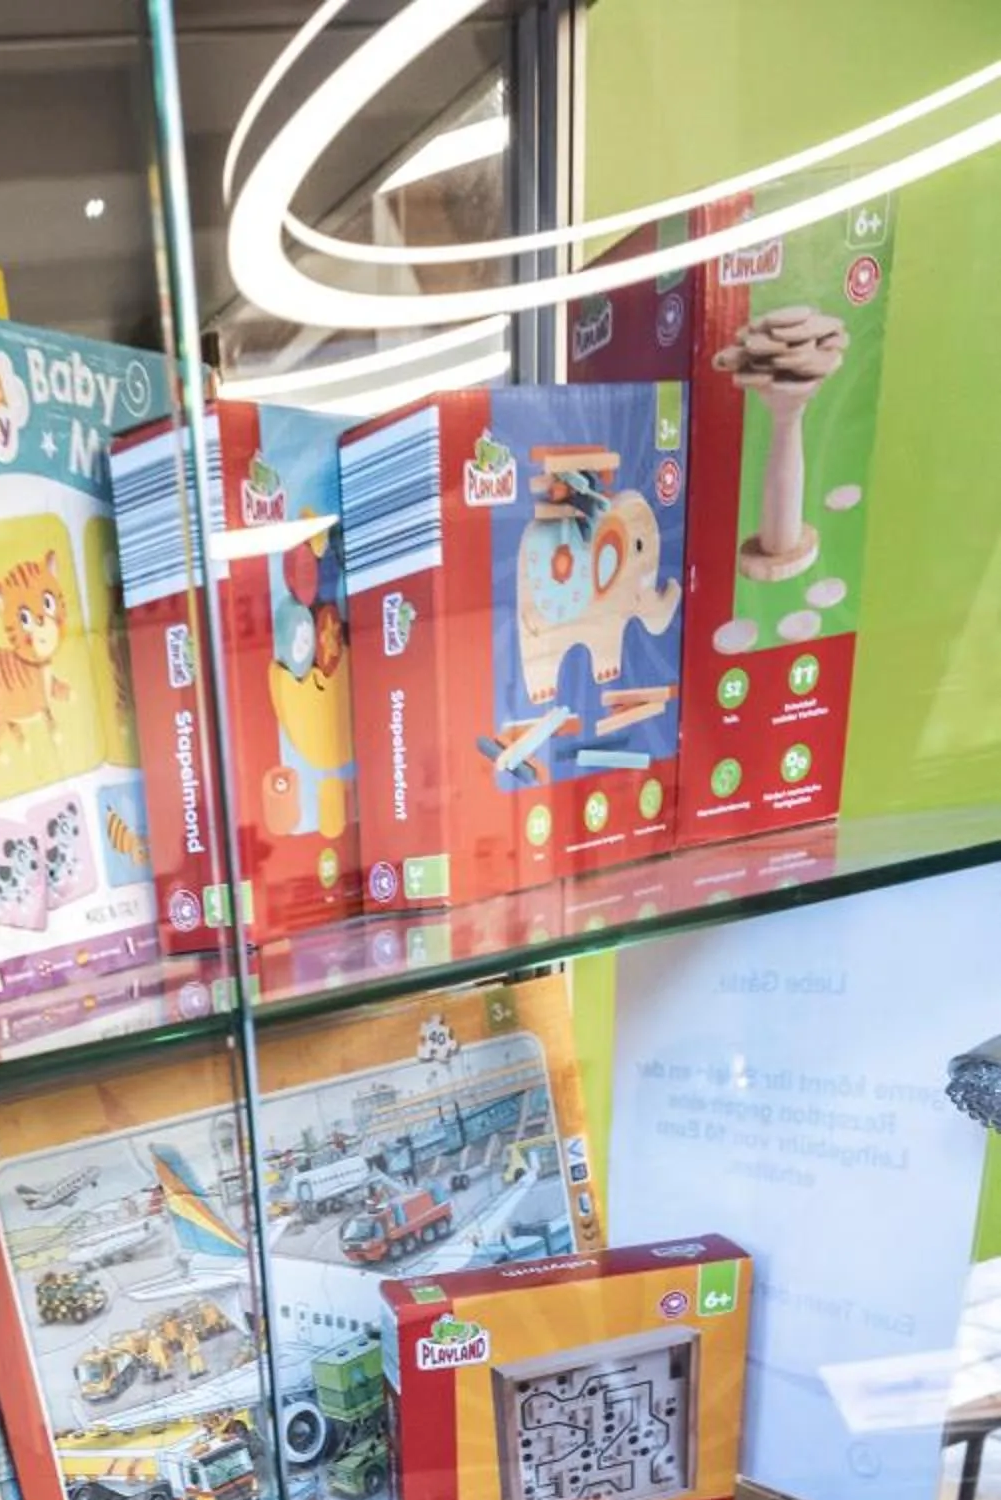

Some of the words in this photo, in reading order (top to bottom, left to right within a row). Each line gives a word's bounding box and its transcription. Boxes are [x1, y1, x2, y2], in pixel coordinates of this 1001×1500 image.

[26, 347, 121, 427] Baby
[703, 1291, 732, 1311] 6+
[420, 1336, 487, 1368] PLAYLAND
